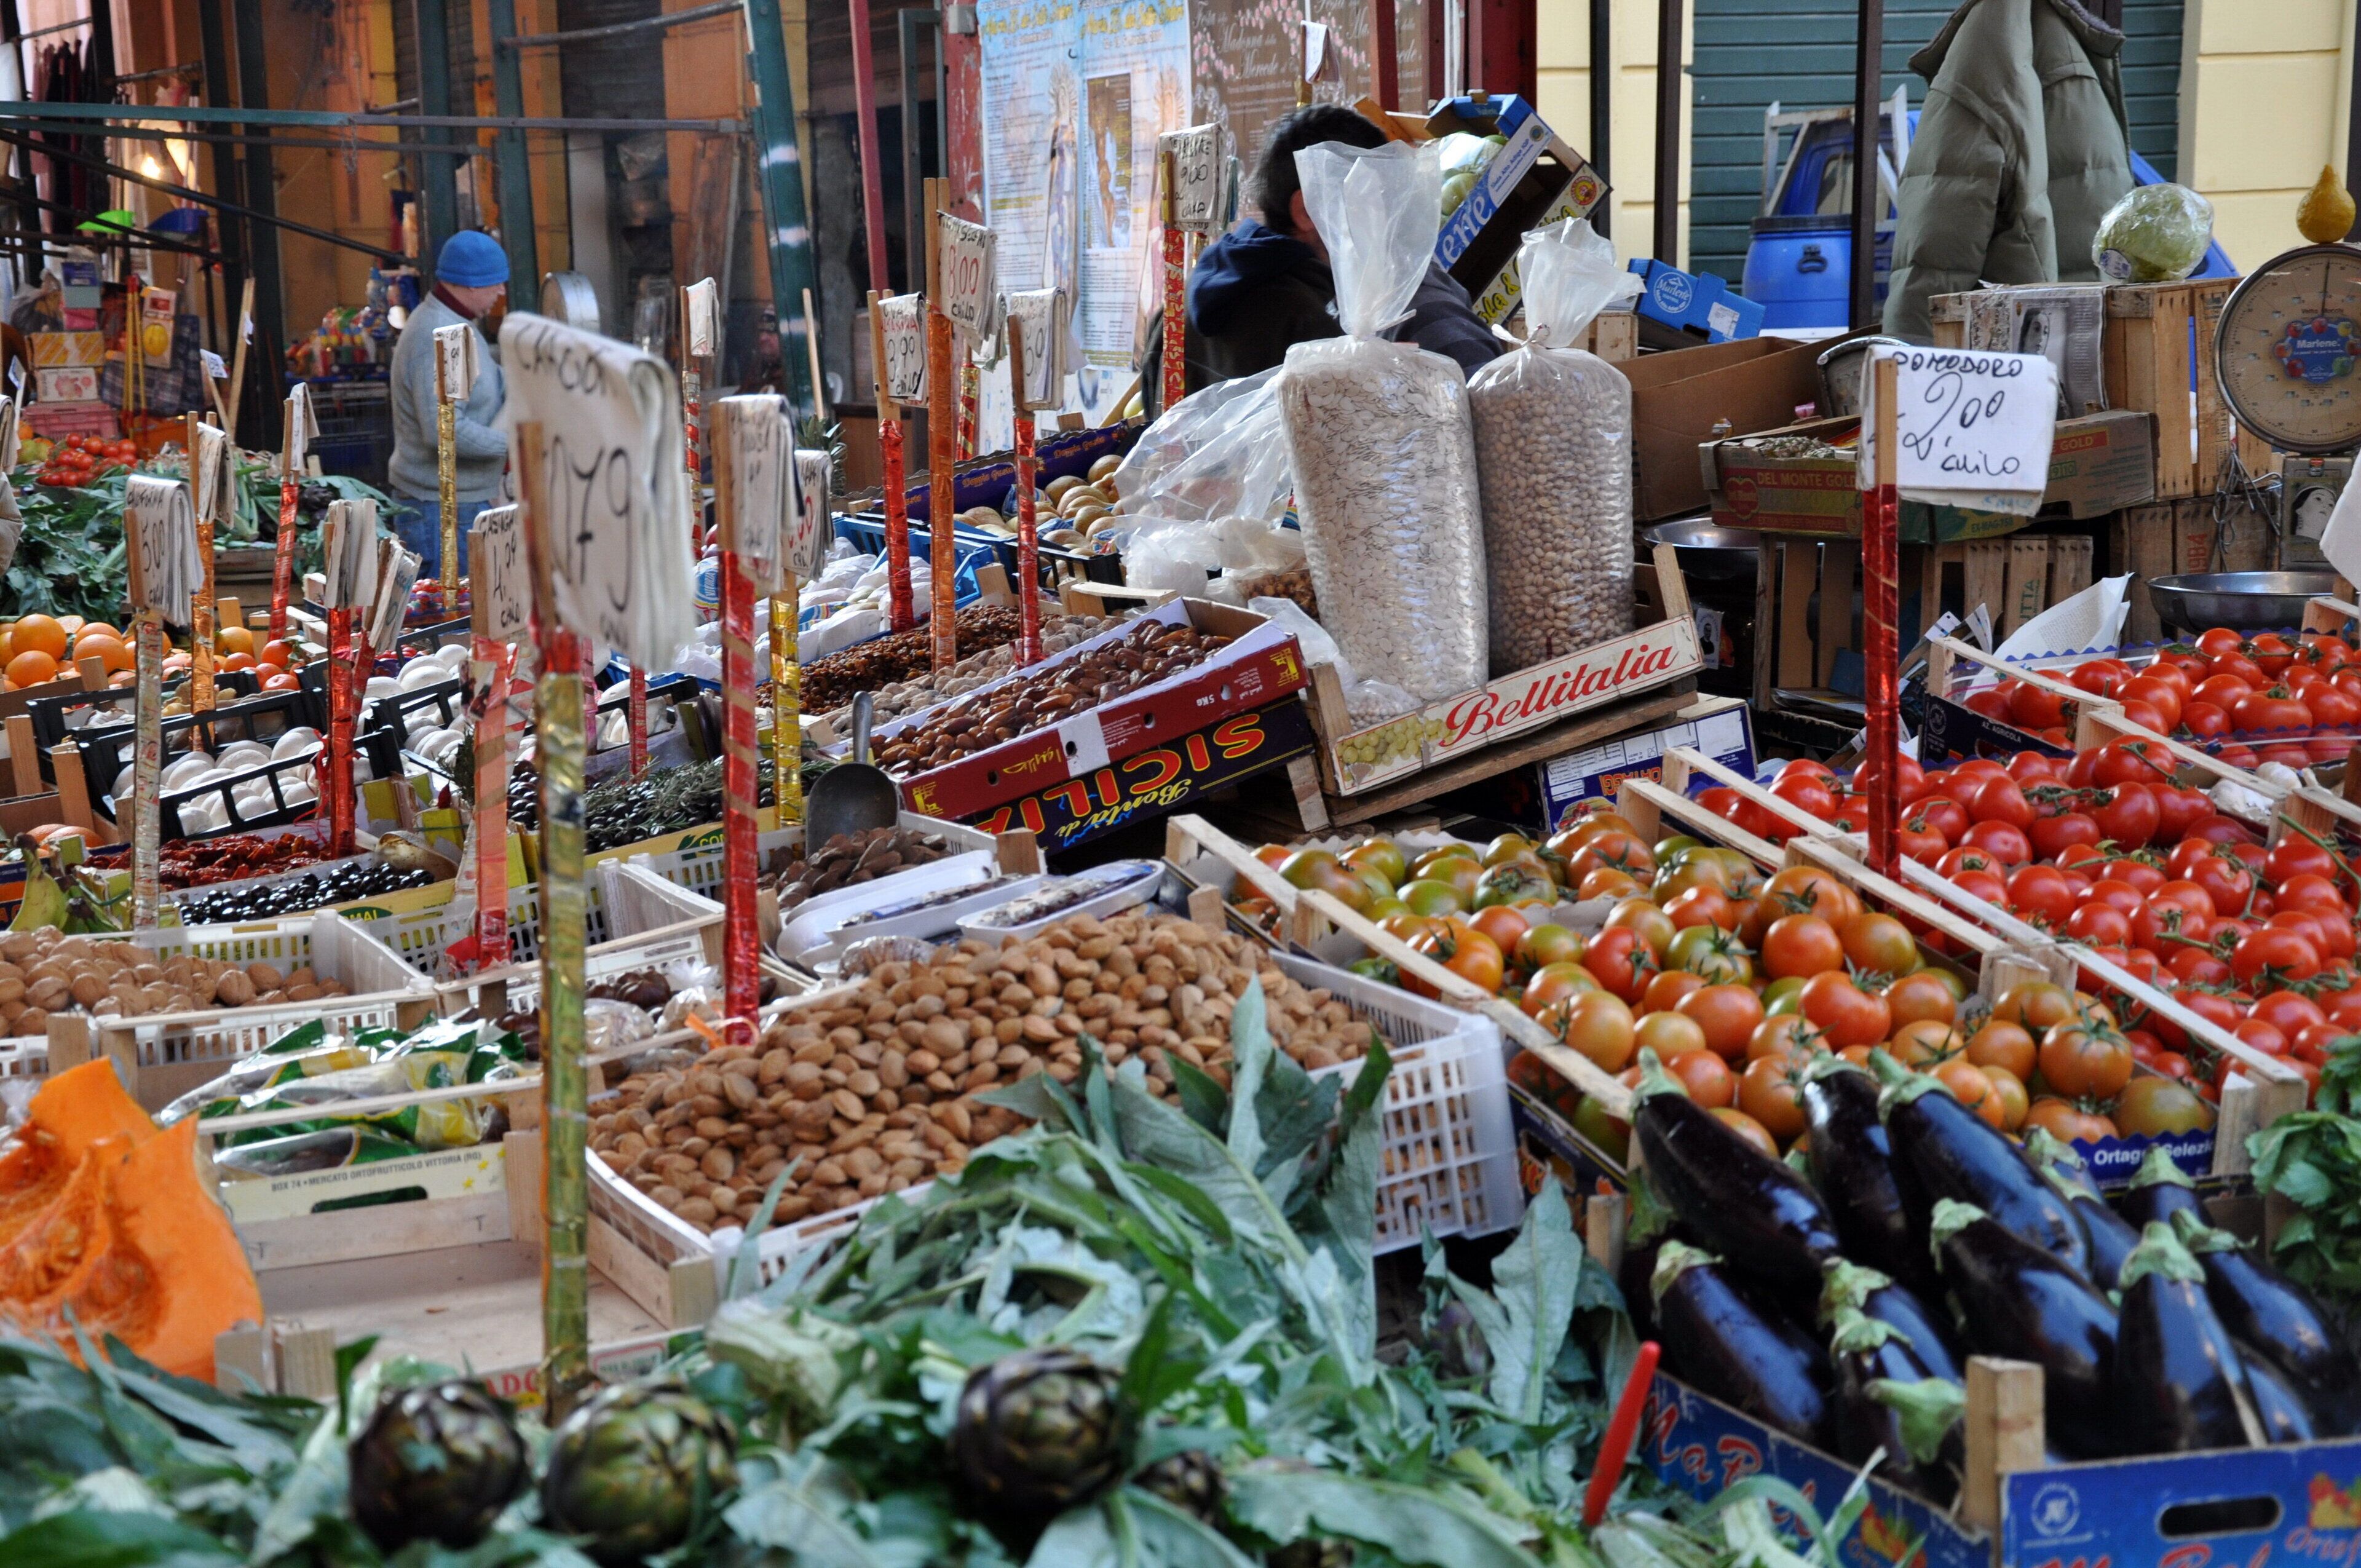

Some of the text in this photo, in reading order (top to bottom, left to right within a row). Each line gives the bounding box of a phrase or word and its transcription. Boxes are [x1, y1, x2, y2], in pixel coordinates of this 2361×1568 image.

[1658, 277, 1691, 302] Marlene
[2060, 436, 2094, 451] GOLD
[1757, 472, 1856, 488] DEL MONTE GOLD
[1439, 643, 1680, 748] Bellitalia
[1980, 721, 2022, 743] AZ. AGRICOLA
[1054, 778, 1192, 837] Bontà di
[271, 1150, 483, 1192] BOX 74 MERCATO ORTOFRUTTICOLO VITTORIA (RG)
